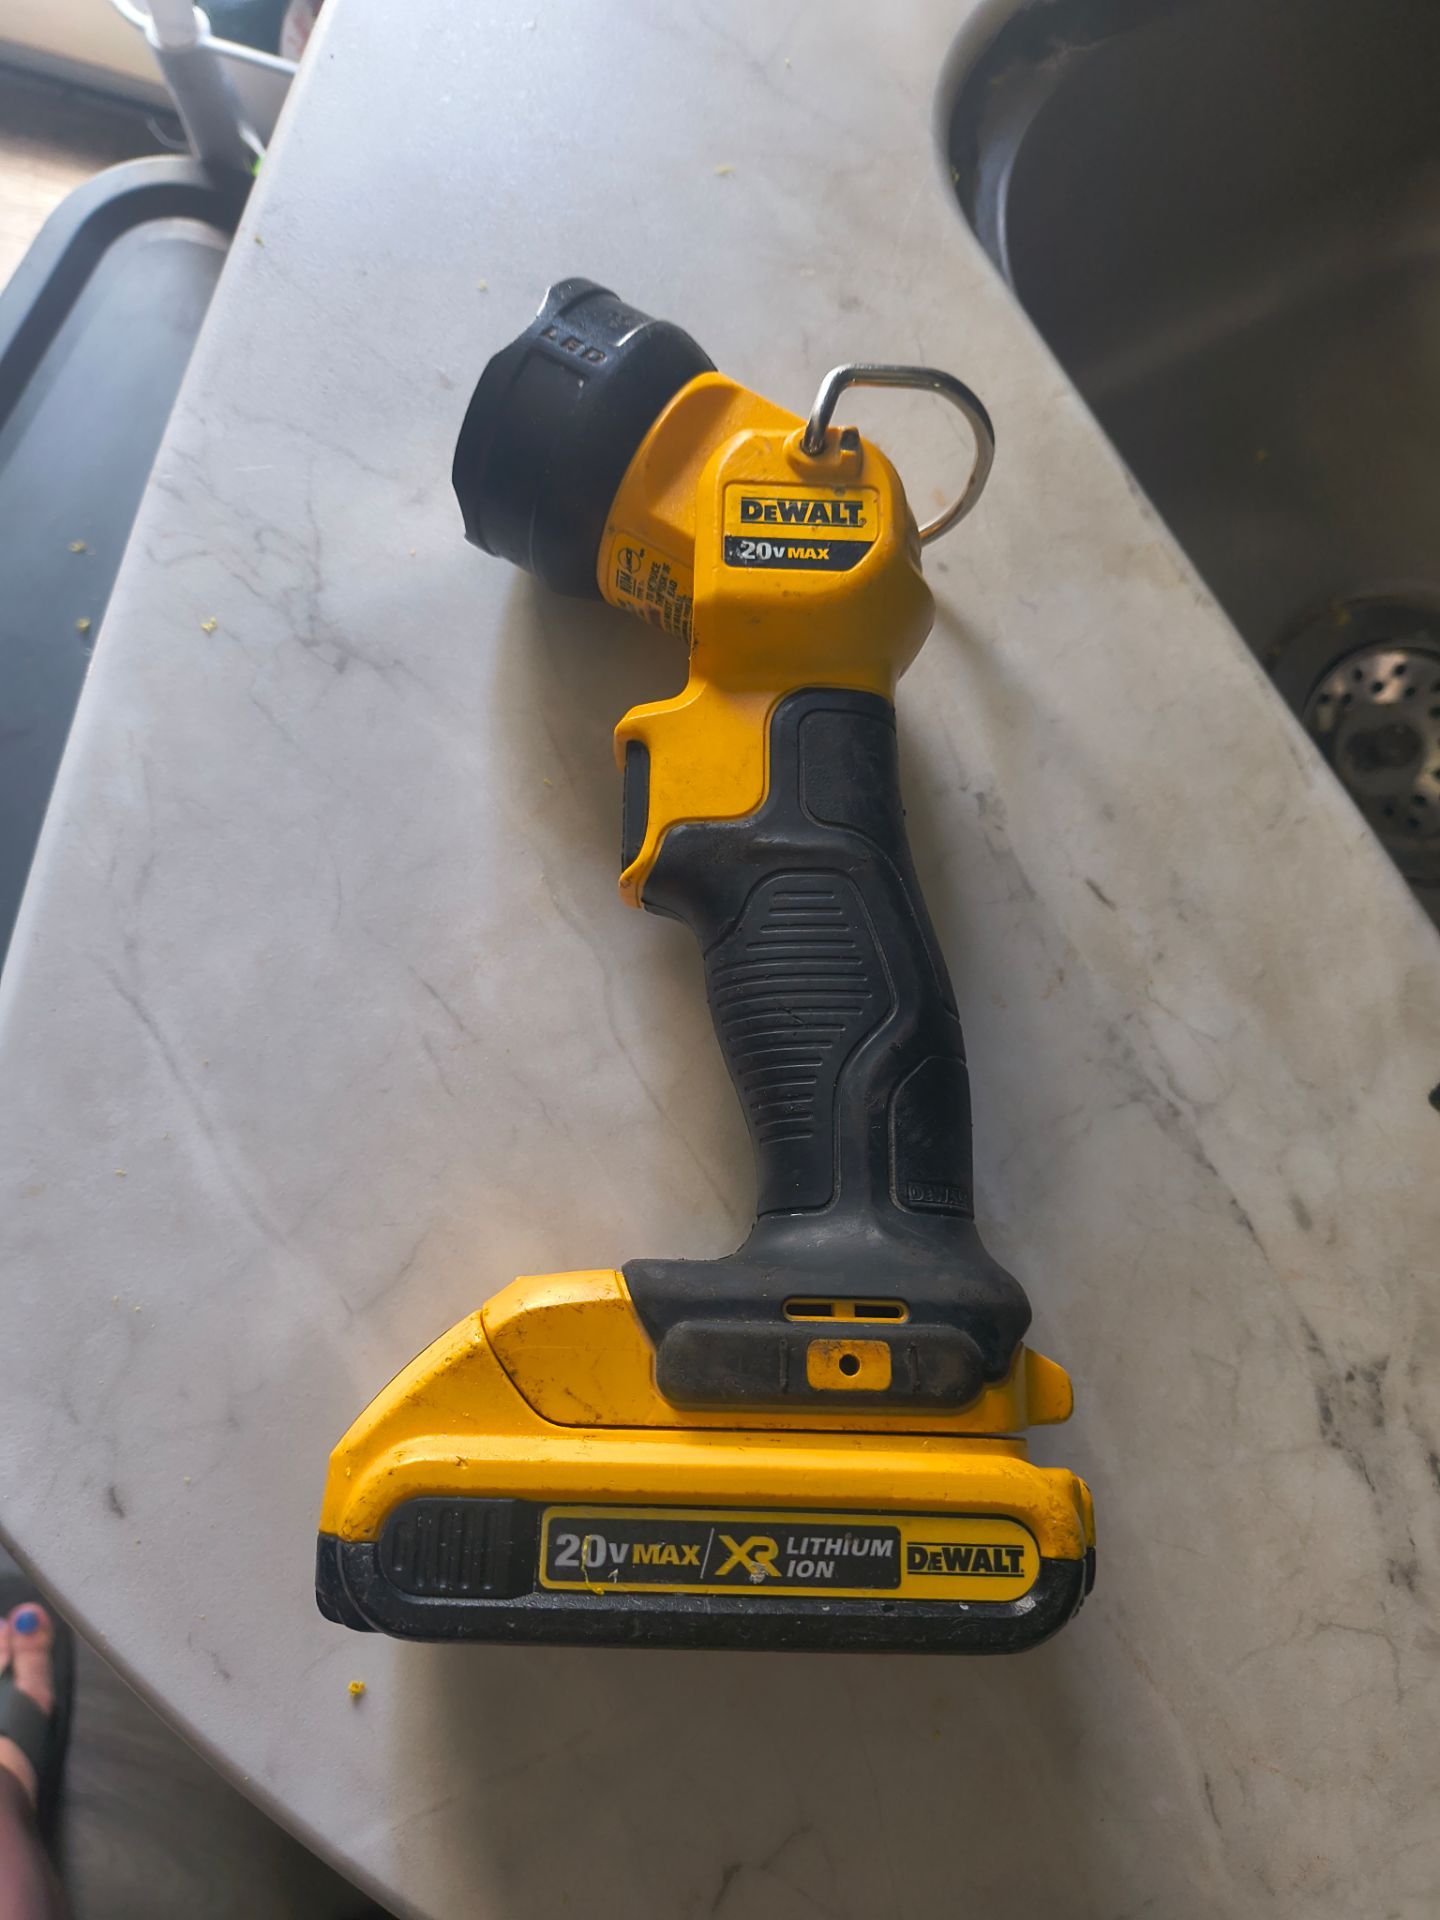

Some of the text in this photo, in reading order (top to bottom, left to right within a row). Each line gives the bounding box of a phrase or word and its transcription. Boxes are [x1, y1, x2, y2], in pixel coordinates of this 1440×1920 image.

[540, 325, 608, 365] LED
[787, 547, 829, 560] MAX
[632, 1543, 700, 1566] MAX
[714, 1534, 782, 1577] XR
[786, 1536, 893, 1557] LITHIUM
[787, 1560, 835, 1578] ION
